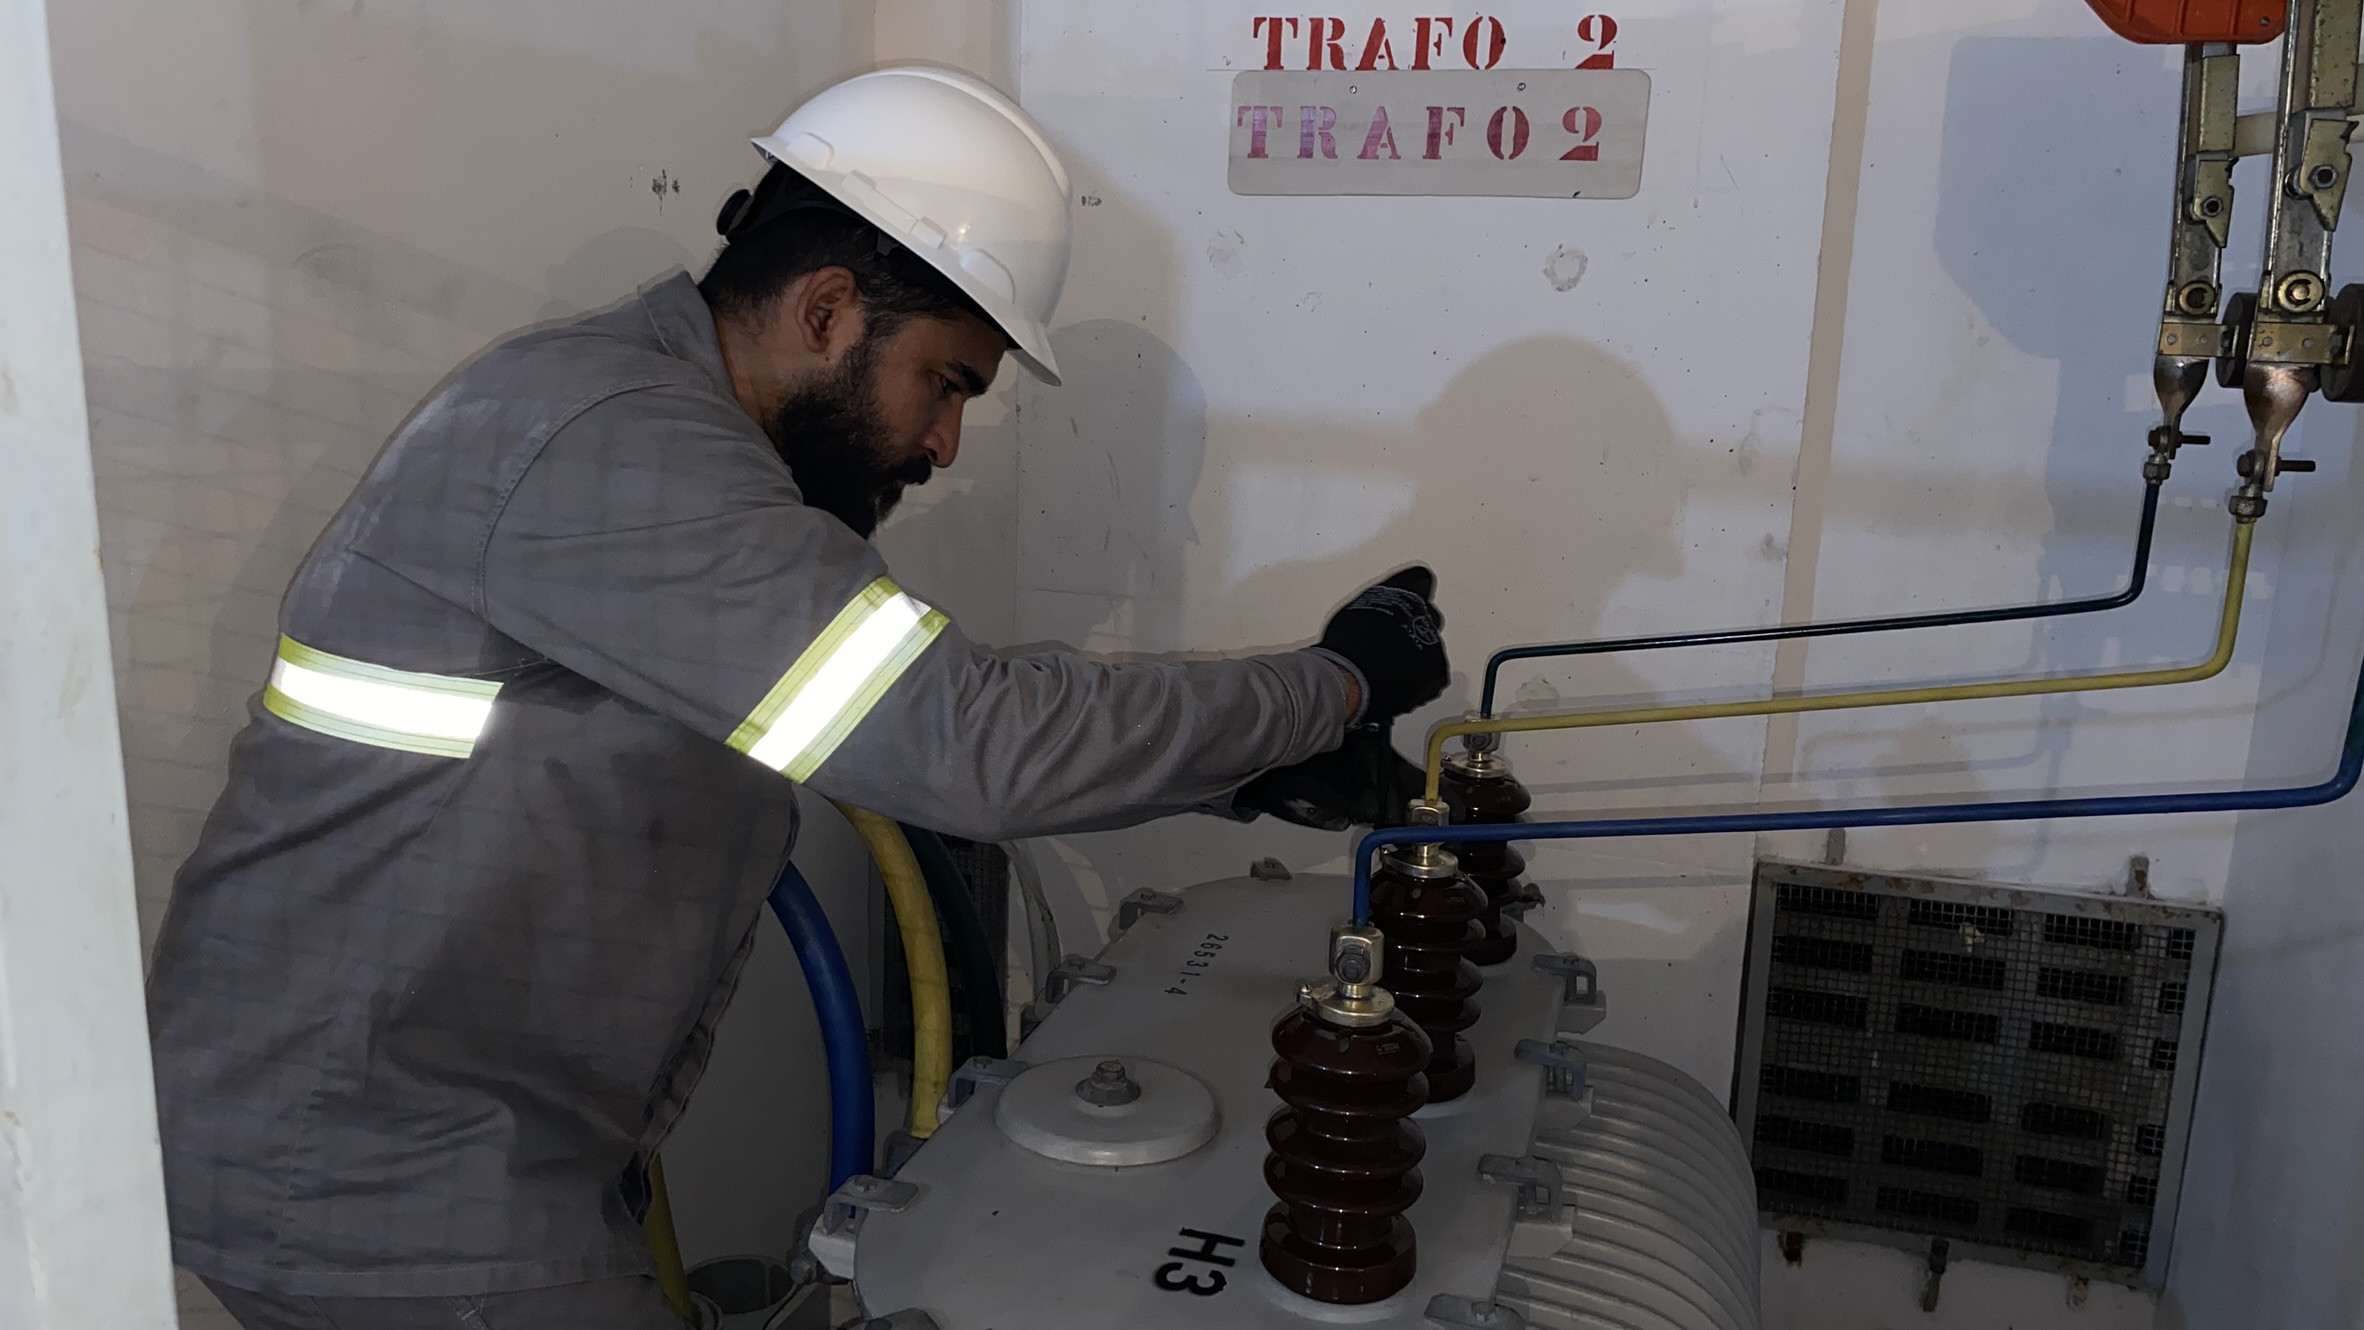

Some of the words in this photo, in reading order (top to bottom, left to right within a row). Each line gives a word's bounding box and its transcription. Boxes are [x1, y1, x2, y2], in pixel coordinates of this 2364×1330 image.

[1253, 15, 1506, 70] TRAFO
[1575, 14, 1618, 70] 2
[1164, 933, 1229, 995] 26531-4
[1155, 1227, 1245, 1296] H3
